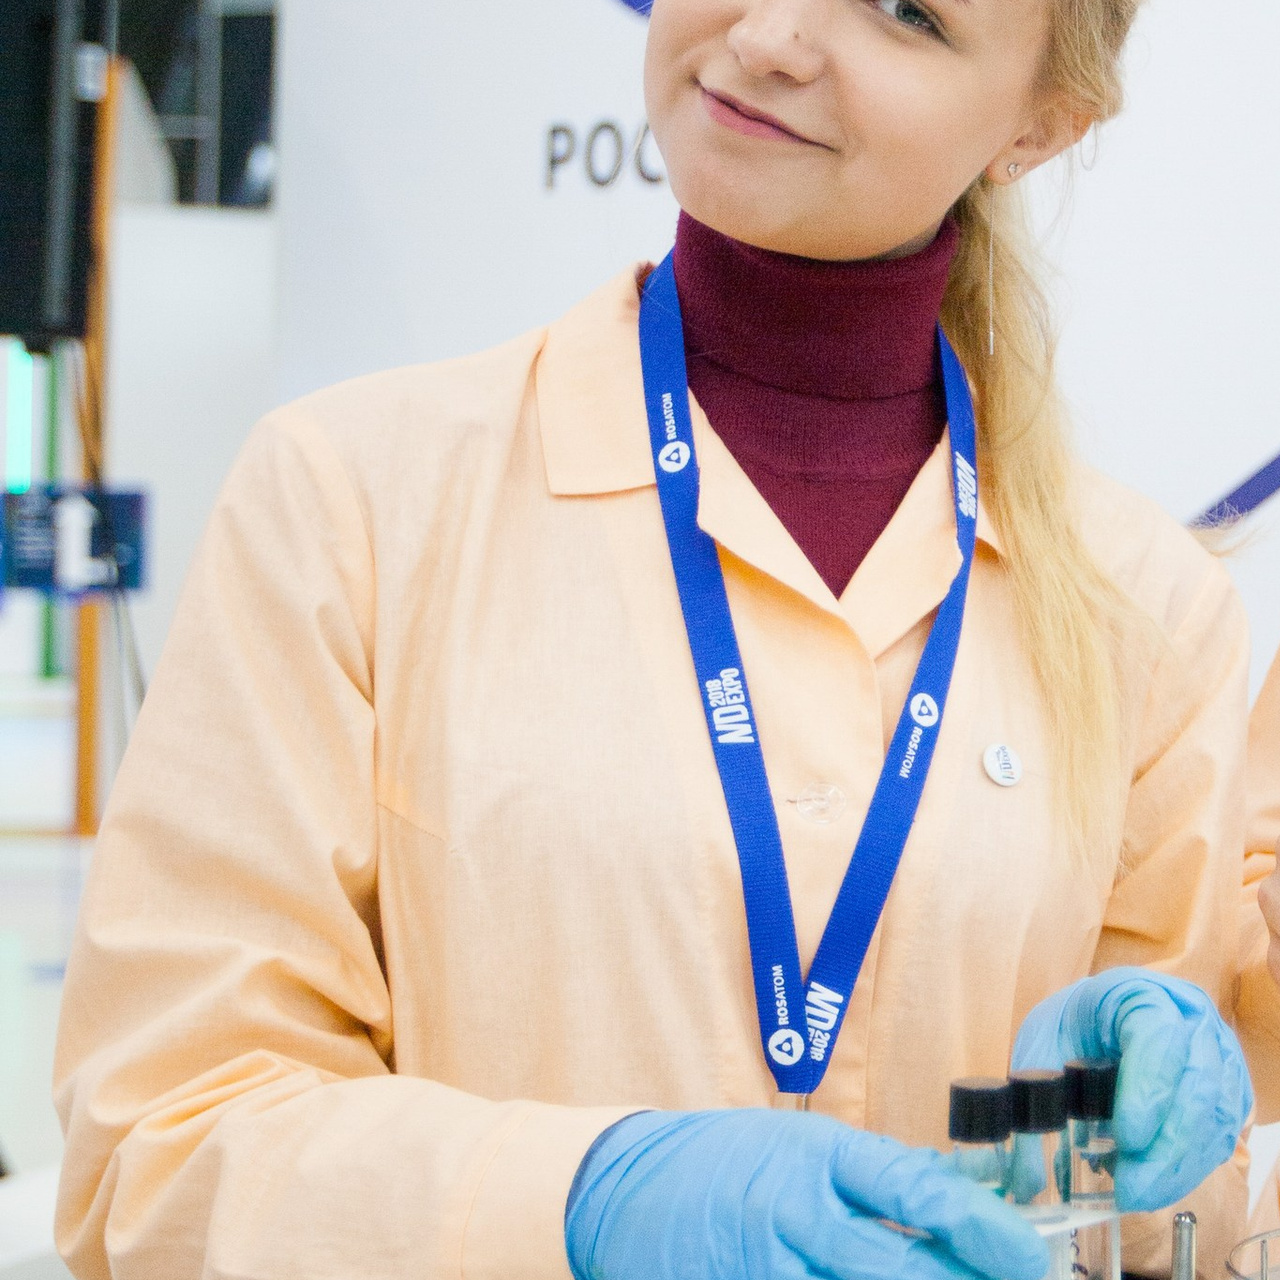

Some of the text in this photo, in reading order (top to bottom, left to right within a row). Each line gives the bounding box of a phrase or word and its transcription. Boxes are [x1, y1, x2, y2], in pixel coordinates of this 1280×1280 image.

[661, 392, 678, 441] ROSATOM
[705, 678, 727, 708] 2018
[712, 667, 755, 744] ND EXPO
[898, 725, 923, 779] ROSATOM
[772, 964, 790, 1026] ROSATOM
[804, 980, 844, 1062] ND 2018
